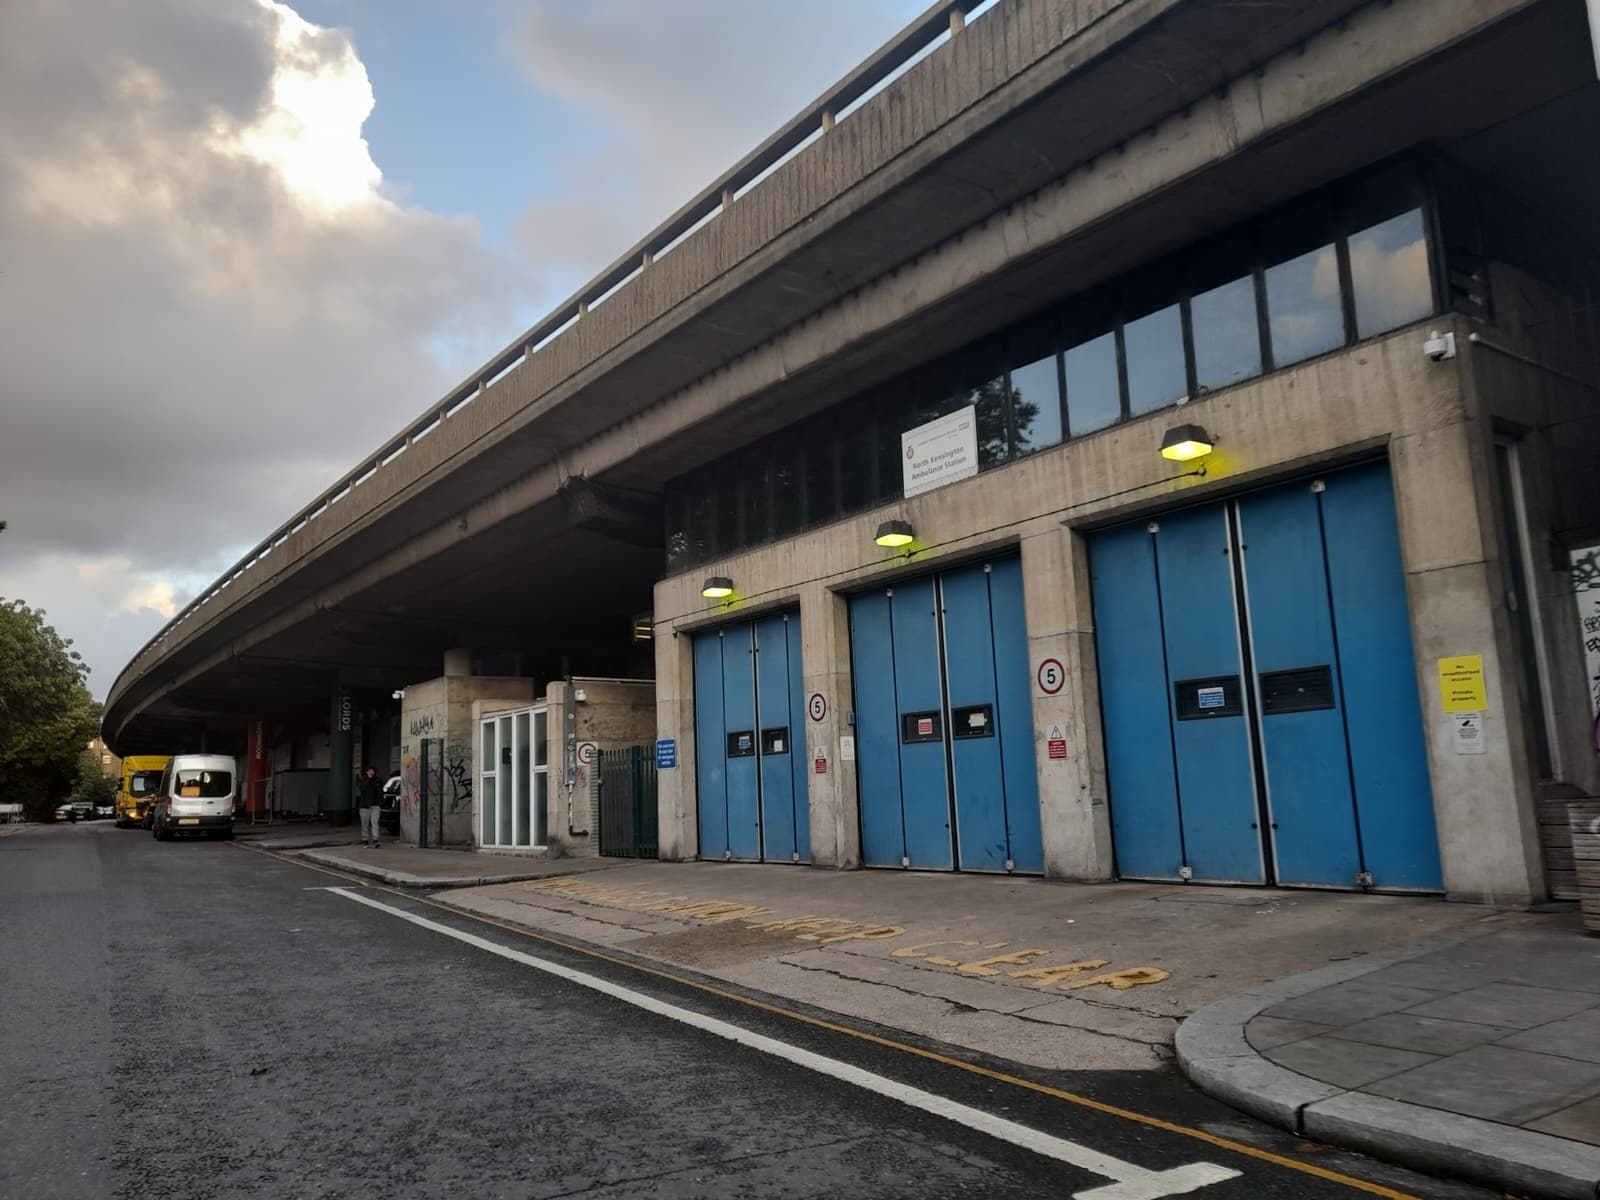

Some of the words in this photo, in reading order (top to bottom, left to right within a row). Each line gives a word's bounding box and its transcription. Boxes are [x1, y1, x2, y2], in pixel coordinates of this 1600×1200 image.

[911, 465, 943, 480] Ambulance
[944, 456, 967, 469] Station
[912, 459, 929, 469] North
[930, 446, 964, 463] Kensington
[1047, 668, 1056, 684] 5
[342, 696, 351, 731] LORDS
[814, 701, 821, 713] 5
